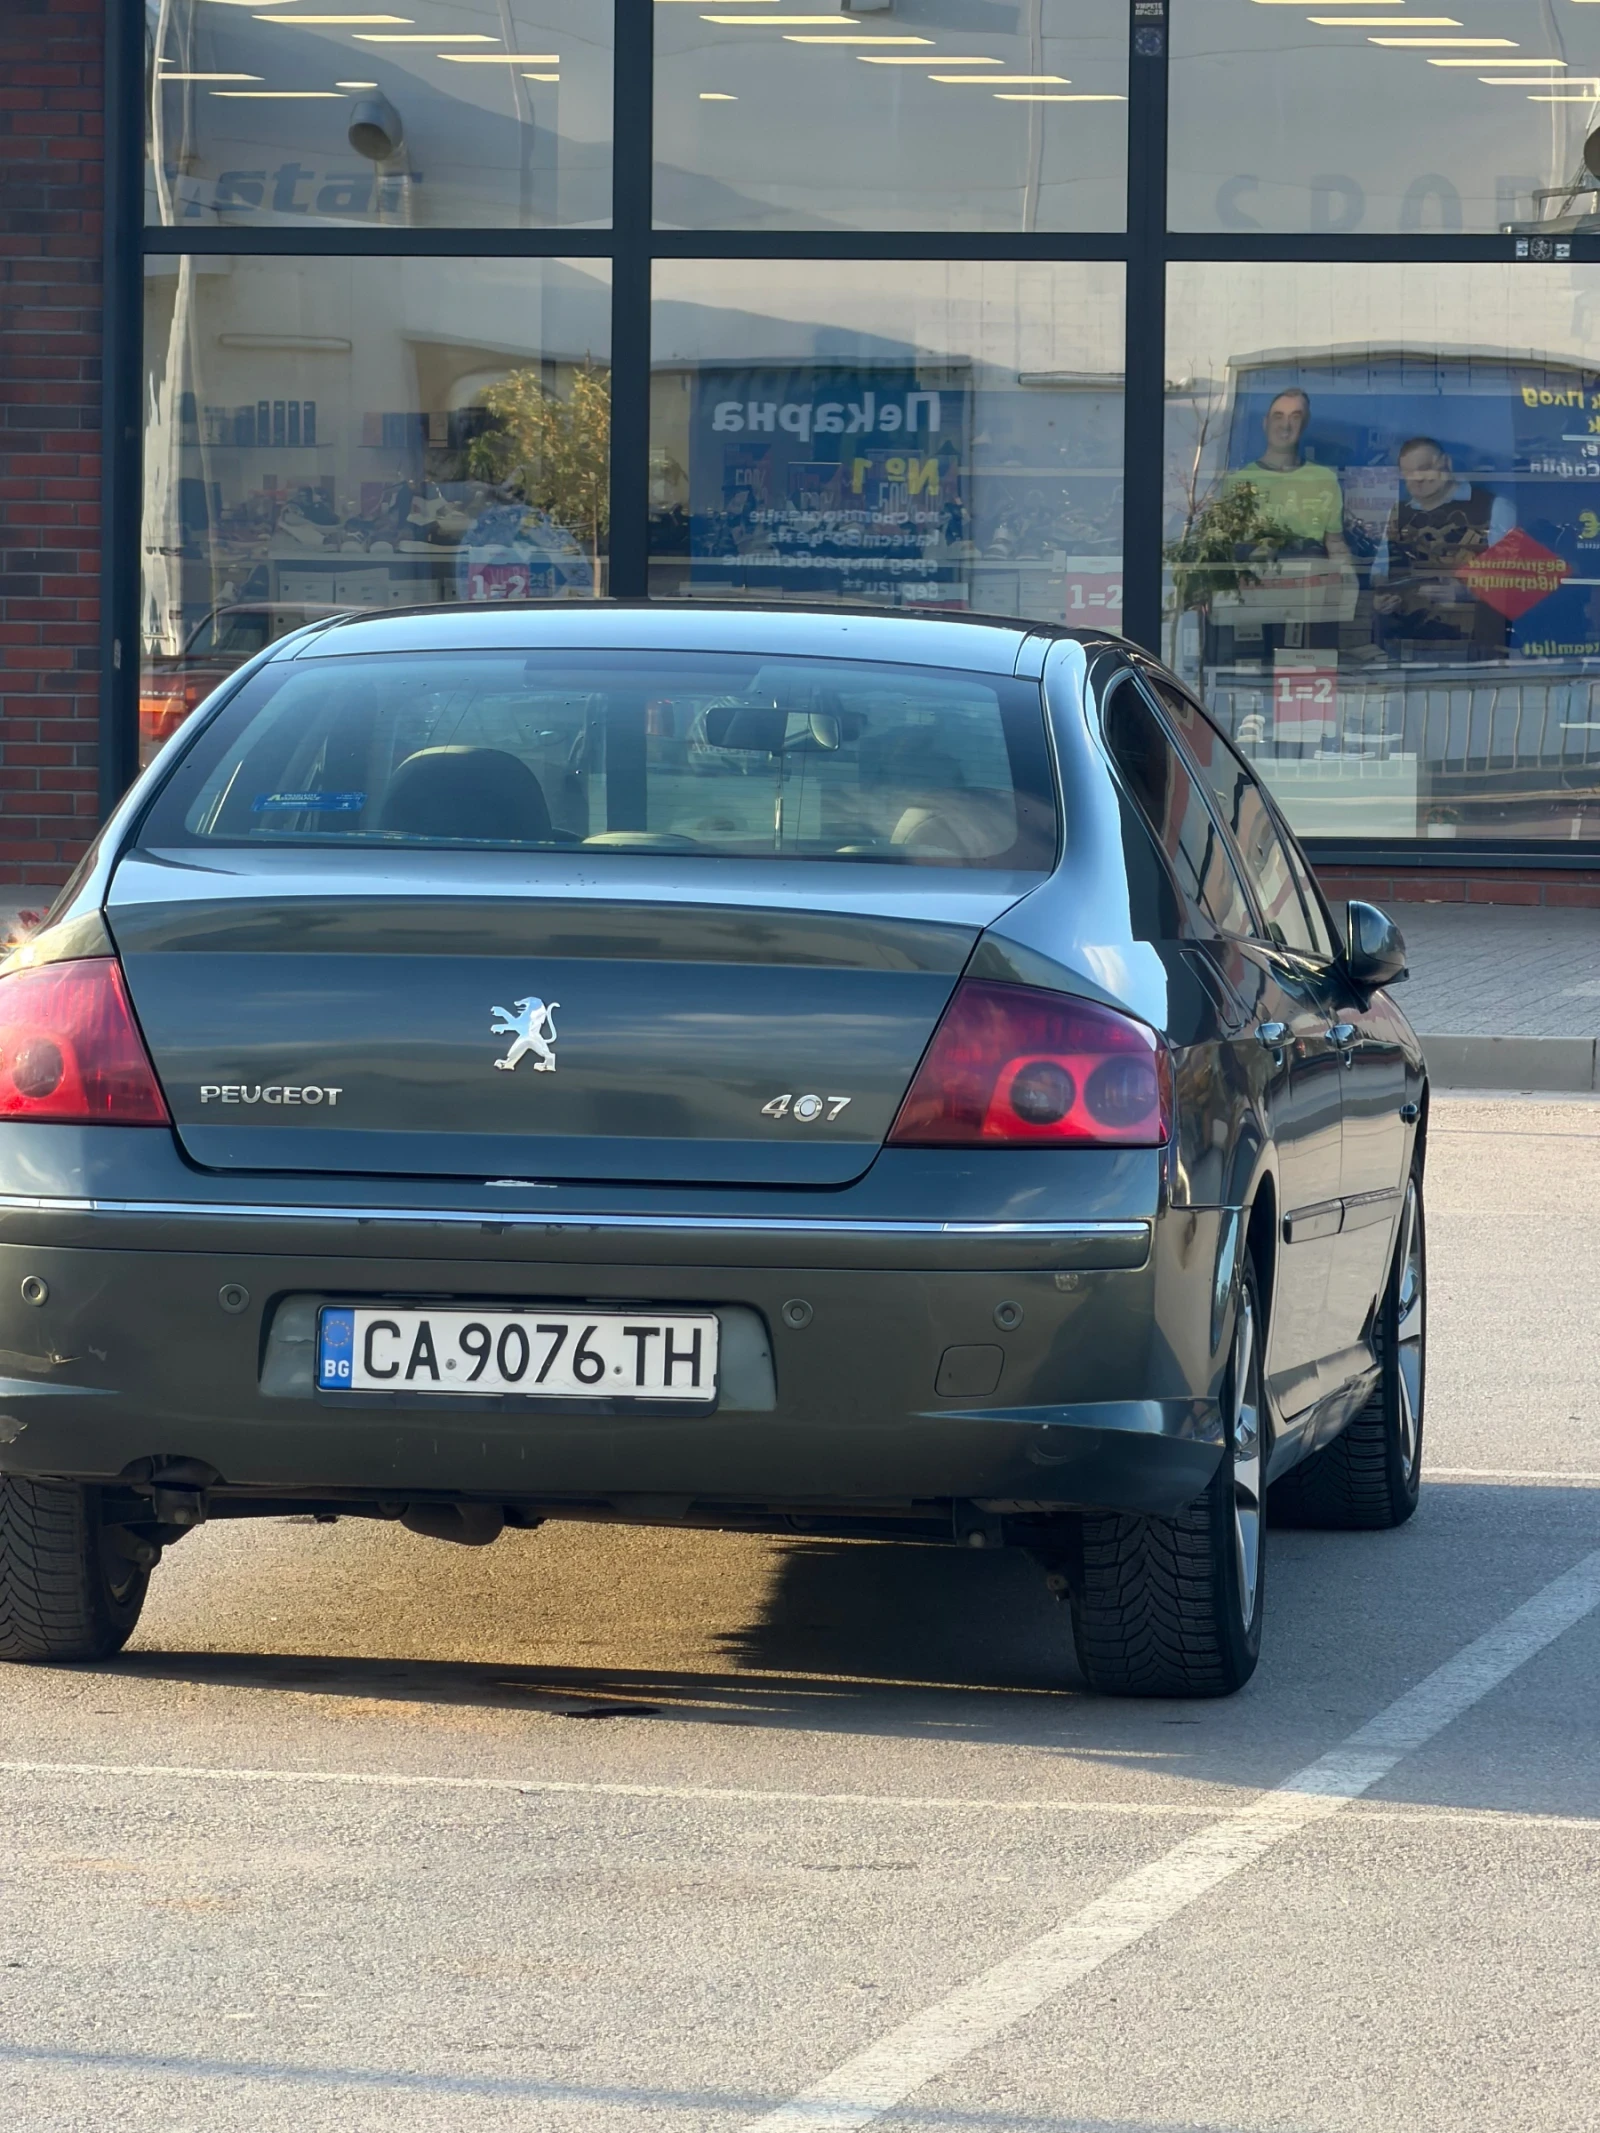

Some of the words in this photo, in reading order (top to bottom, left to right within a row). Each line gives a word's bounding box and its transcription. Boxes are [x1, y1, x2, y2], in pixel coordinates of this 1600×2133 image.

[1277, 677, 1334, 704] 1=2
[199, 1085, 343, 1106] PEUGEOT
[760, 1093, 852, 1122] 407
[458, 1322, 606, 1385] 9076
[622, 1325, 702, 1387] TH
[324, 1359, 350, 1378] BG
